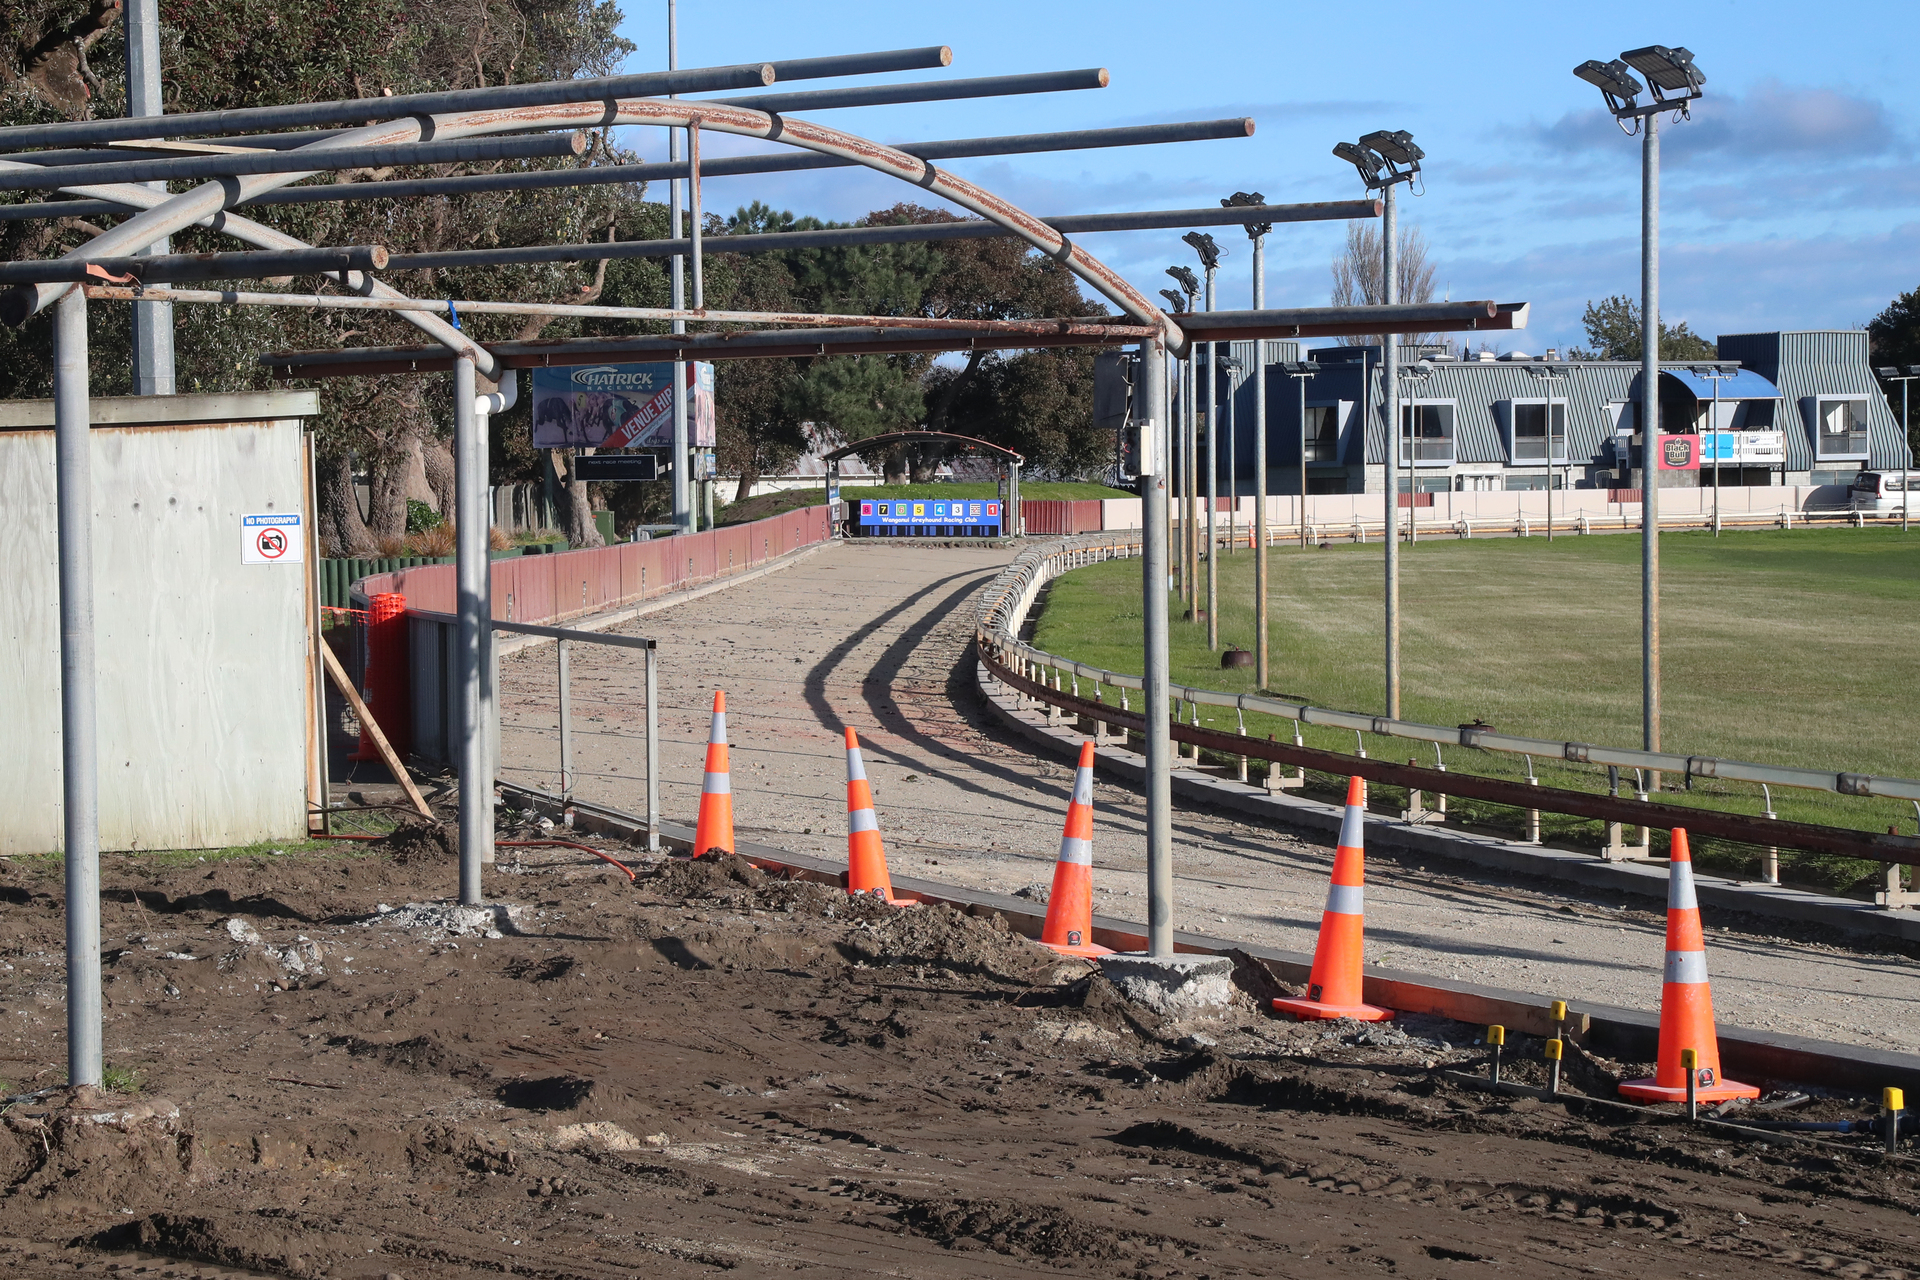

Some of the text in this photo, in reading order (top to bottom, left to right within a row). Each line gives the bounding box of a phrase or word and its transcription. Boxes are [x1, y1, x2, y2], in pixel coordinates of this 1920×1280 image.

[587, 373, 653, 386] HATRICK
[621, 403, 658, 440] VENUE
[654, 385, 672, 412] HIR
[1665, 444, 1690, 452] Black
[990, 506, 995, 514] 1
[256, 516, 298, 524] PHOTOGRAPHY
